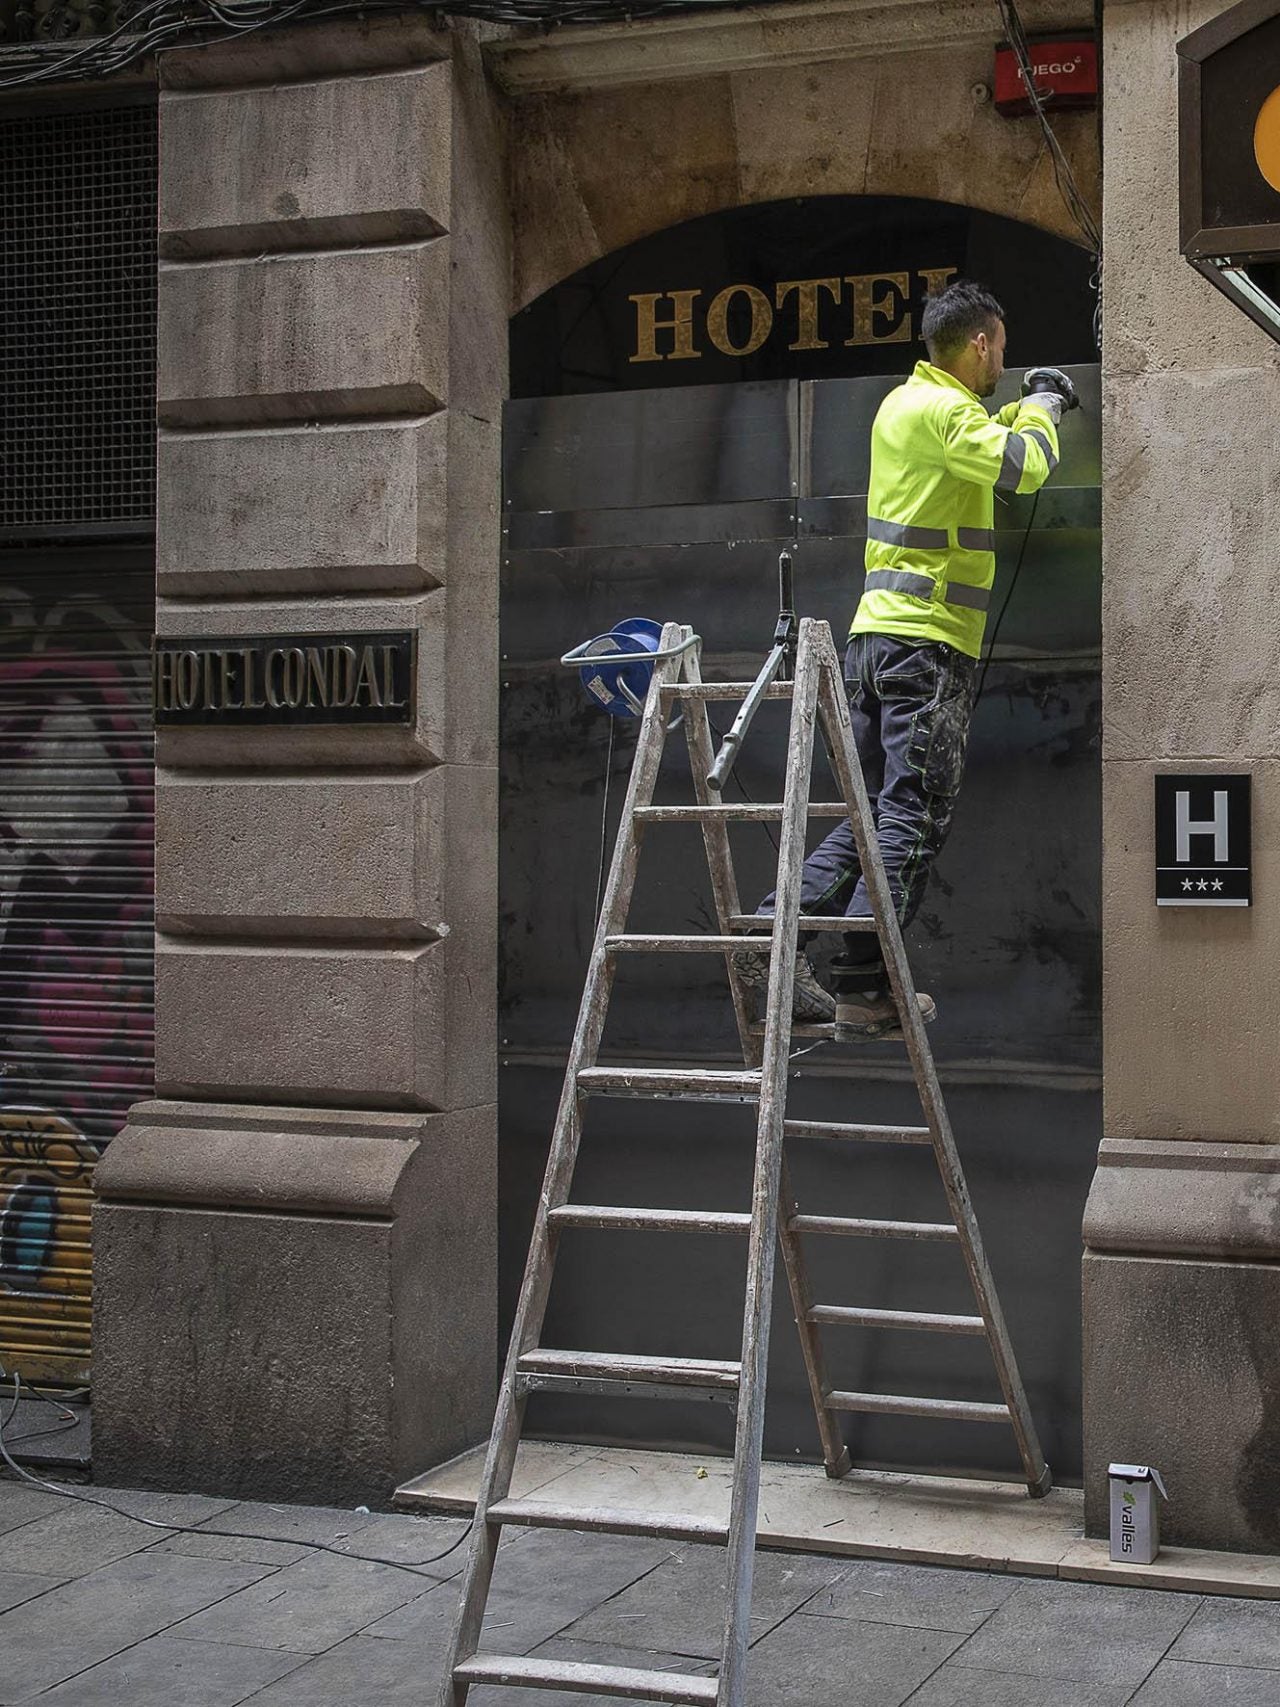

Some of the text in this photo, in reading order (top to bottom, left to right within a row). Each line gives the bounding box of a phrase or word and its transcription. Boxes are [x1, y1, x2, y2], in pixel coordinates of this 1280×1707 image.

[156, 644, 406, 711] HOTEL CONDAL
[1175, 790, 1229, 862] H
